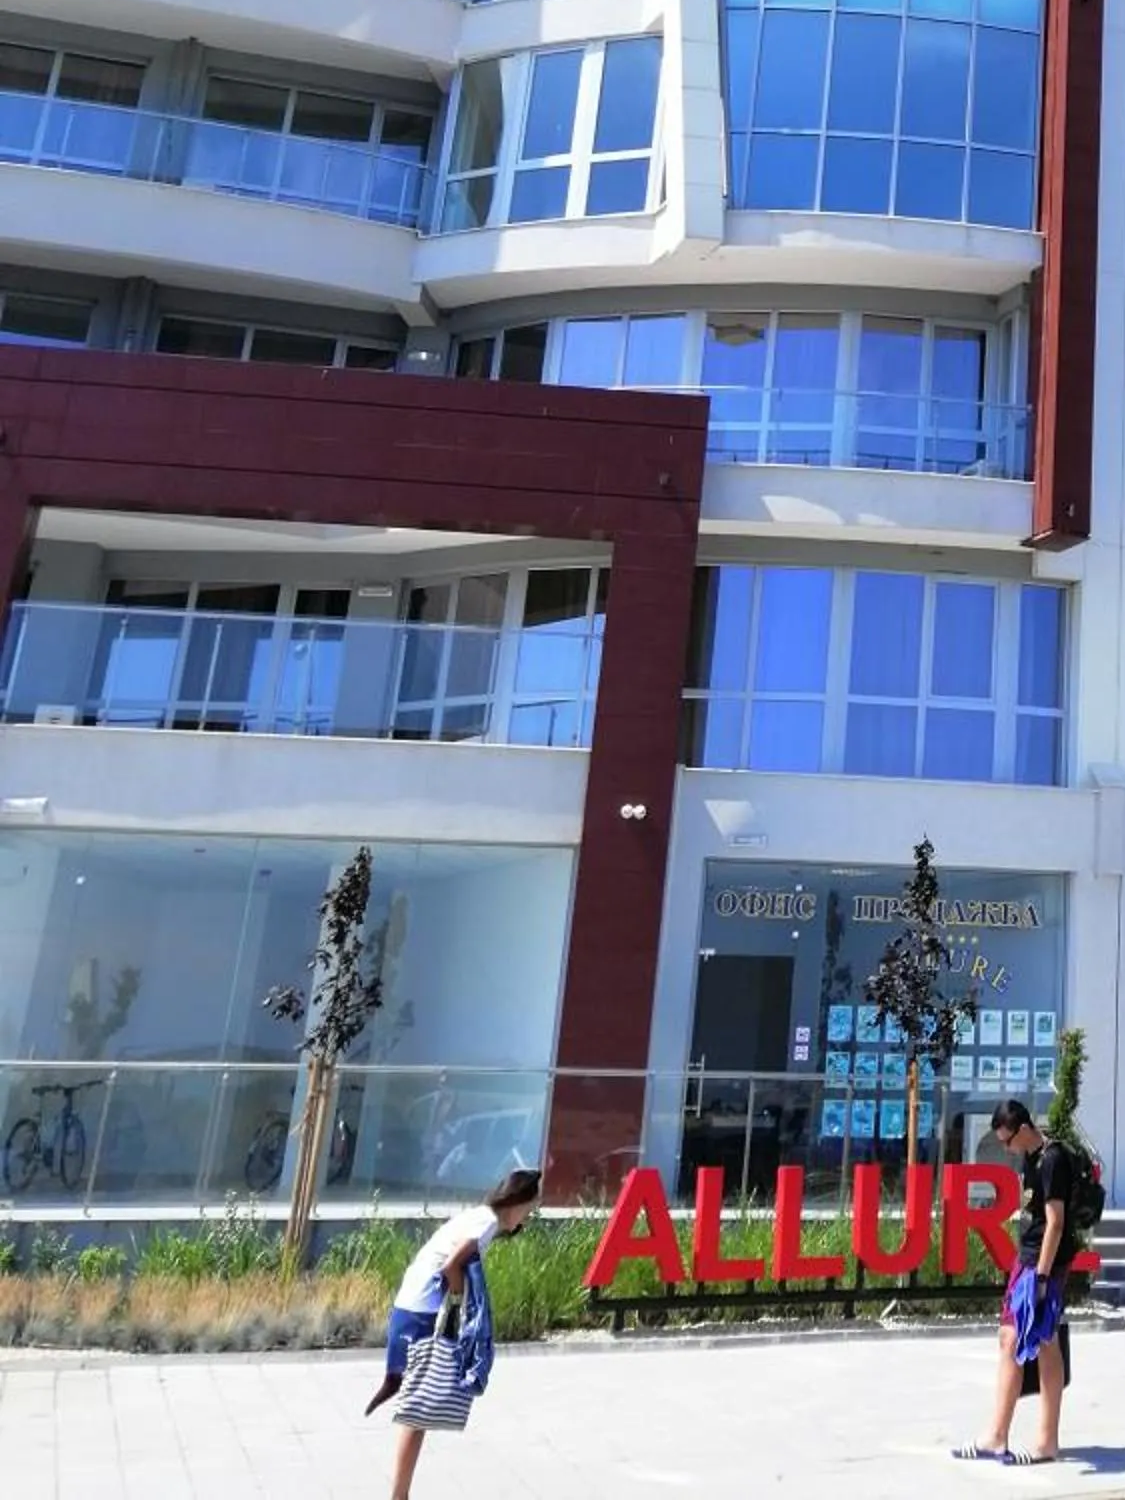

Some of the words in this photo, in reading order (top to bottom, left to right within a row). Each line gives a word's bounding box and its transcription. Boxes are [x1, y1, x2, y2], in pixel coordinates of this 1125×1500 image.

[714, 889, 817, 921] ОФИС
[853, 895, 1042, 929] ПРДАЖБА
[582, 1163, 1101, 1288] ALLUR
